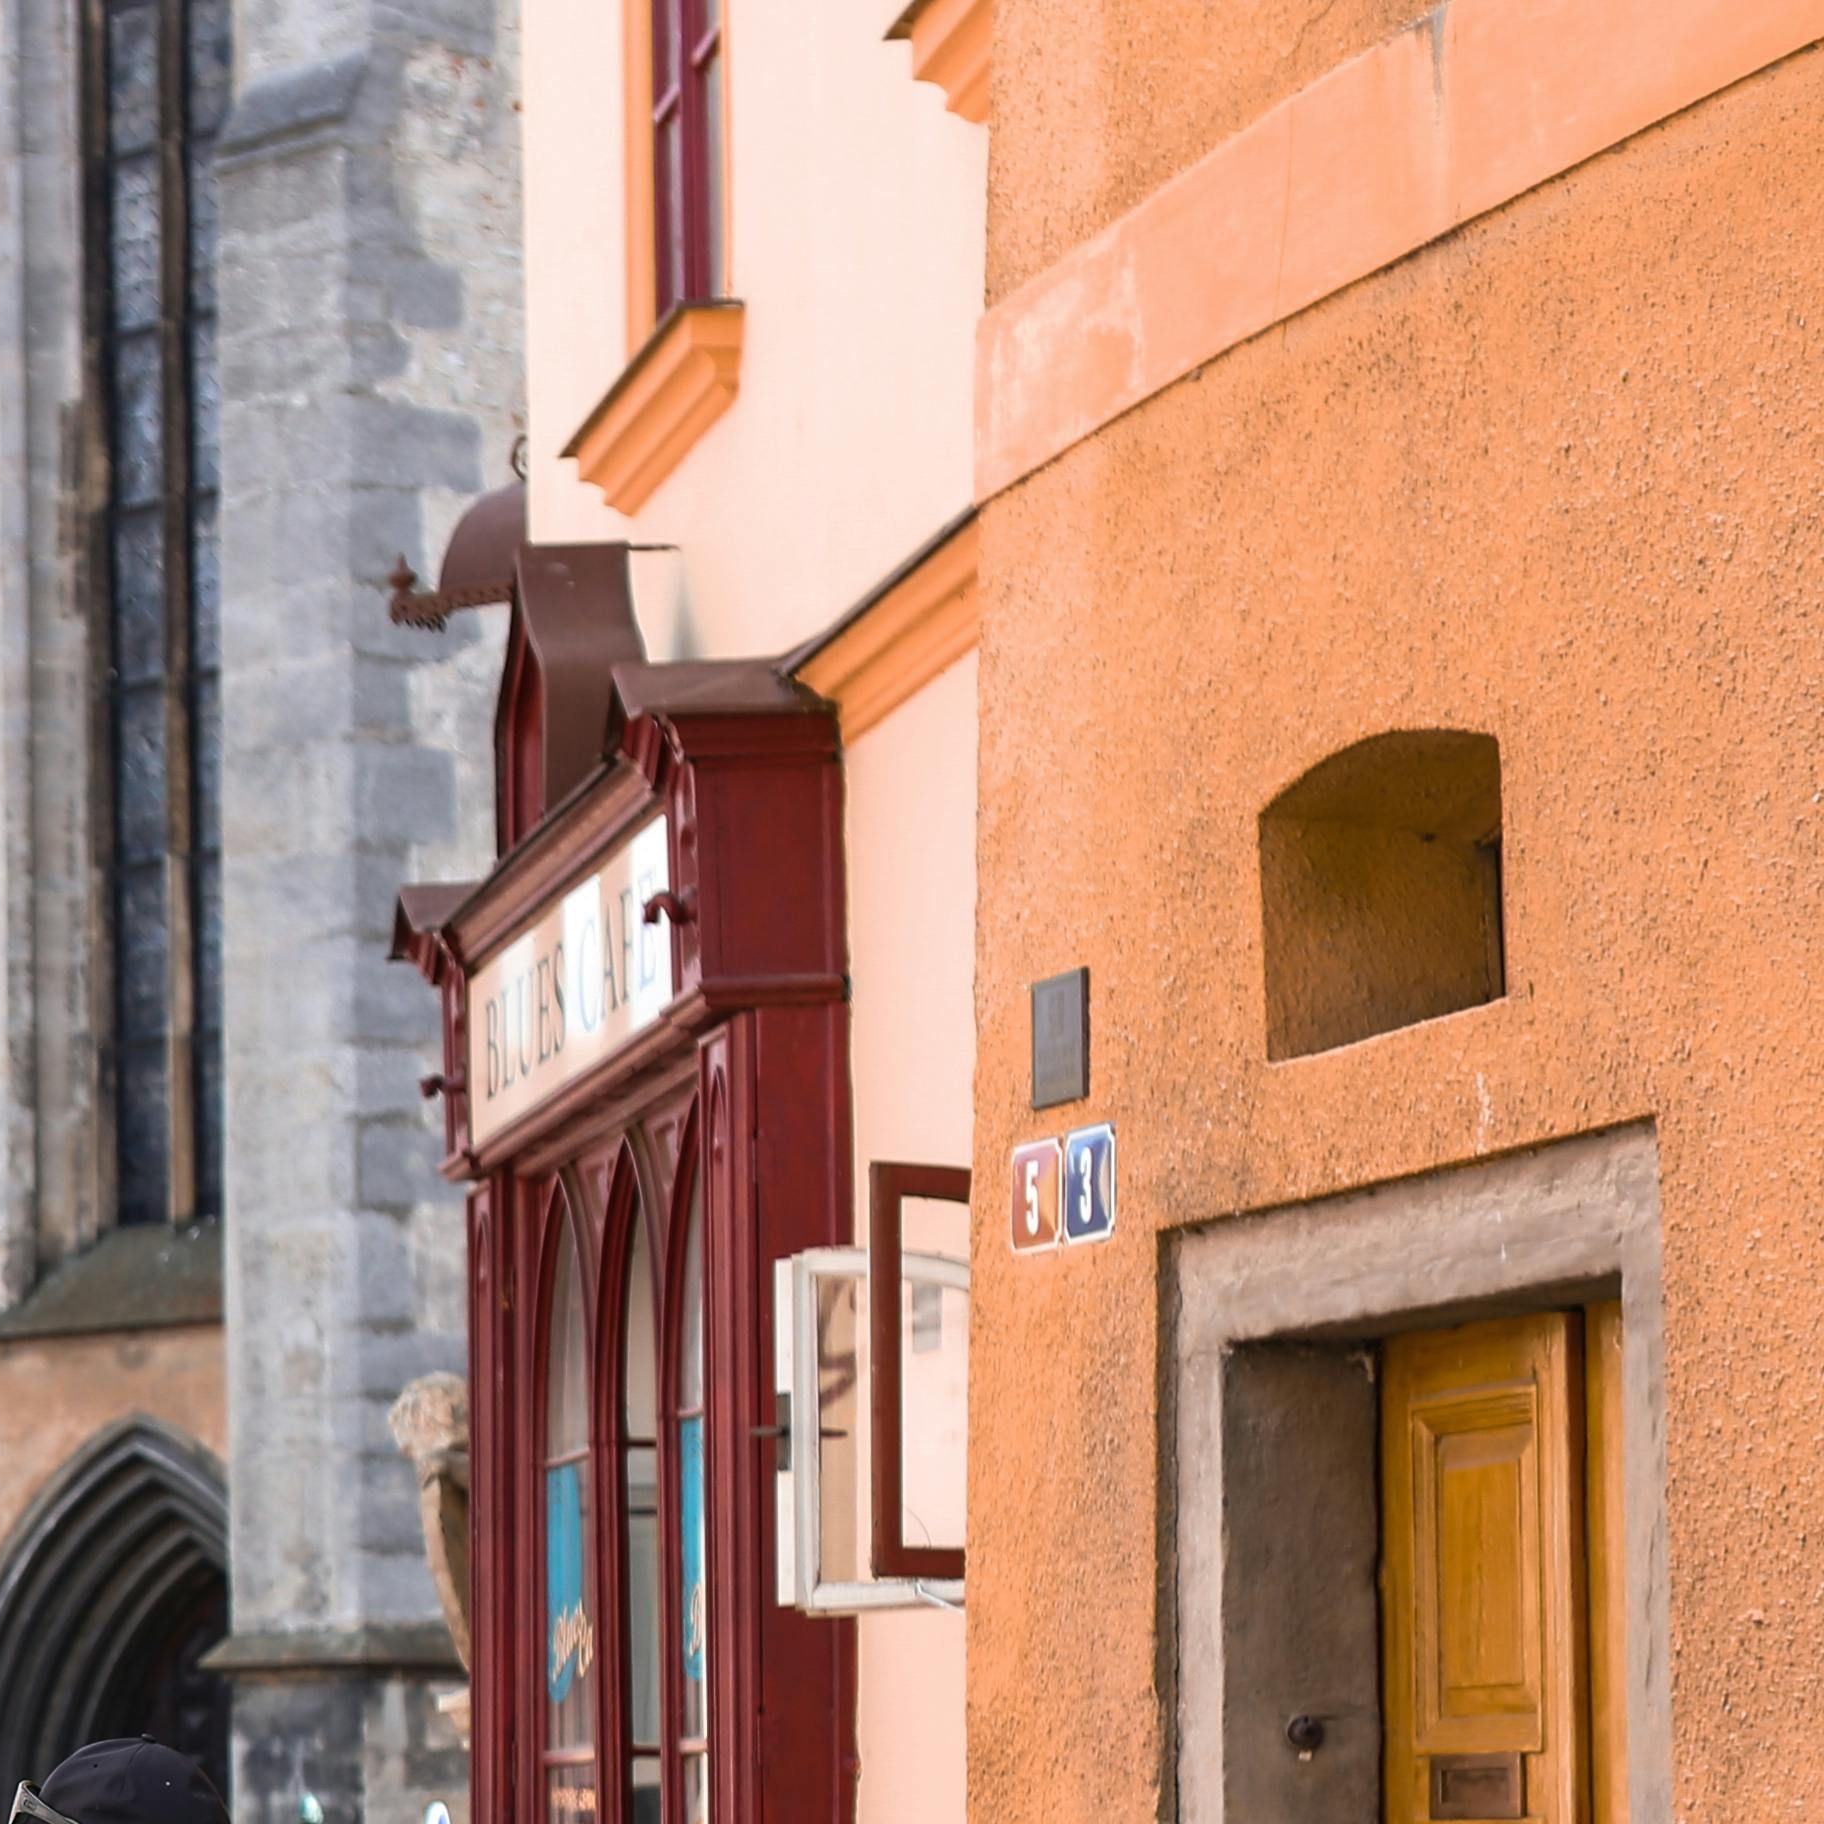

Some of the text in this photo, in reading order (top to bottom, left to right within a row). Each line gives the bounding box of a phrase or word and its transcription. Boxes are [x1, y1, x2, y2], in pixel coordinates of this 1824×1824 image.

[485, 943, 567, 1101] BLUES
[1024, 1159, 1040, 1237] 5
[1079, 1146, 1093, 1224] 3
